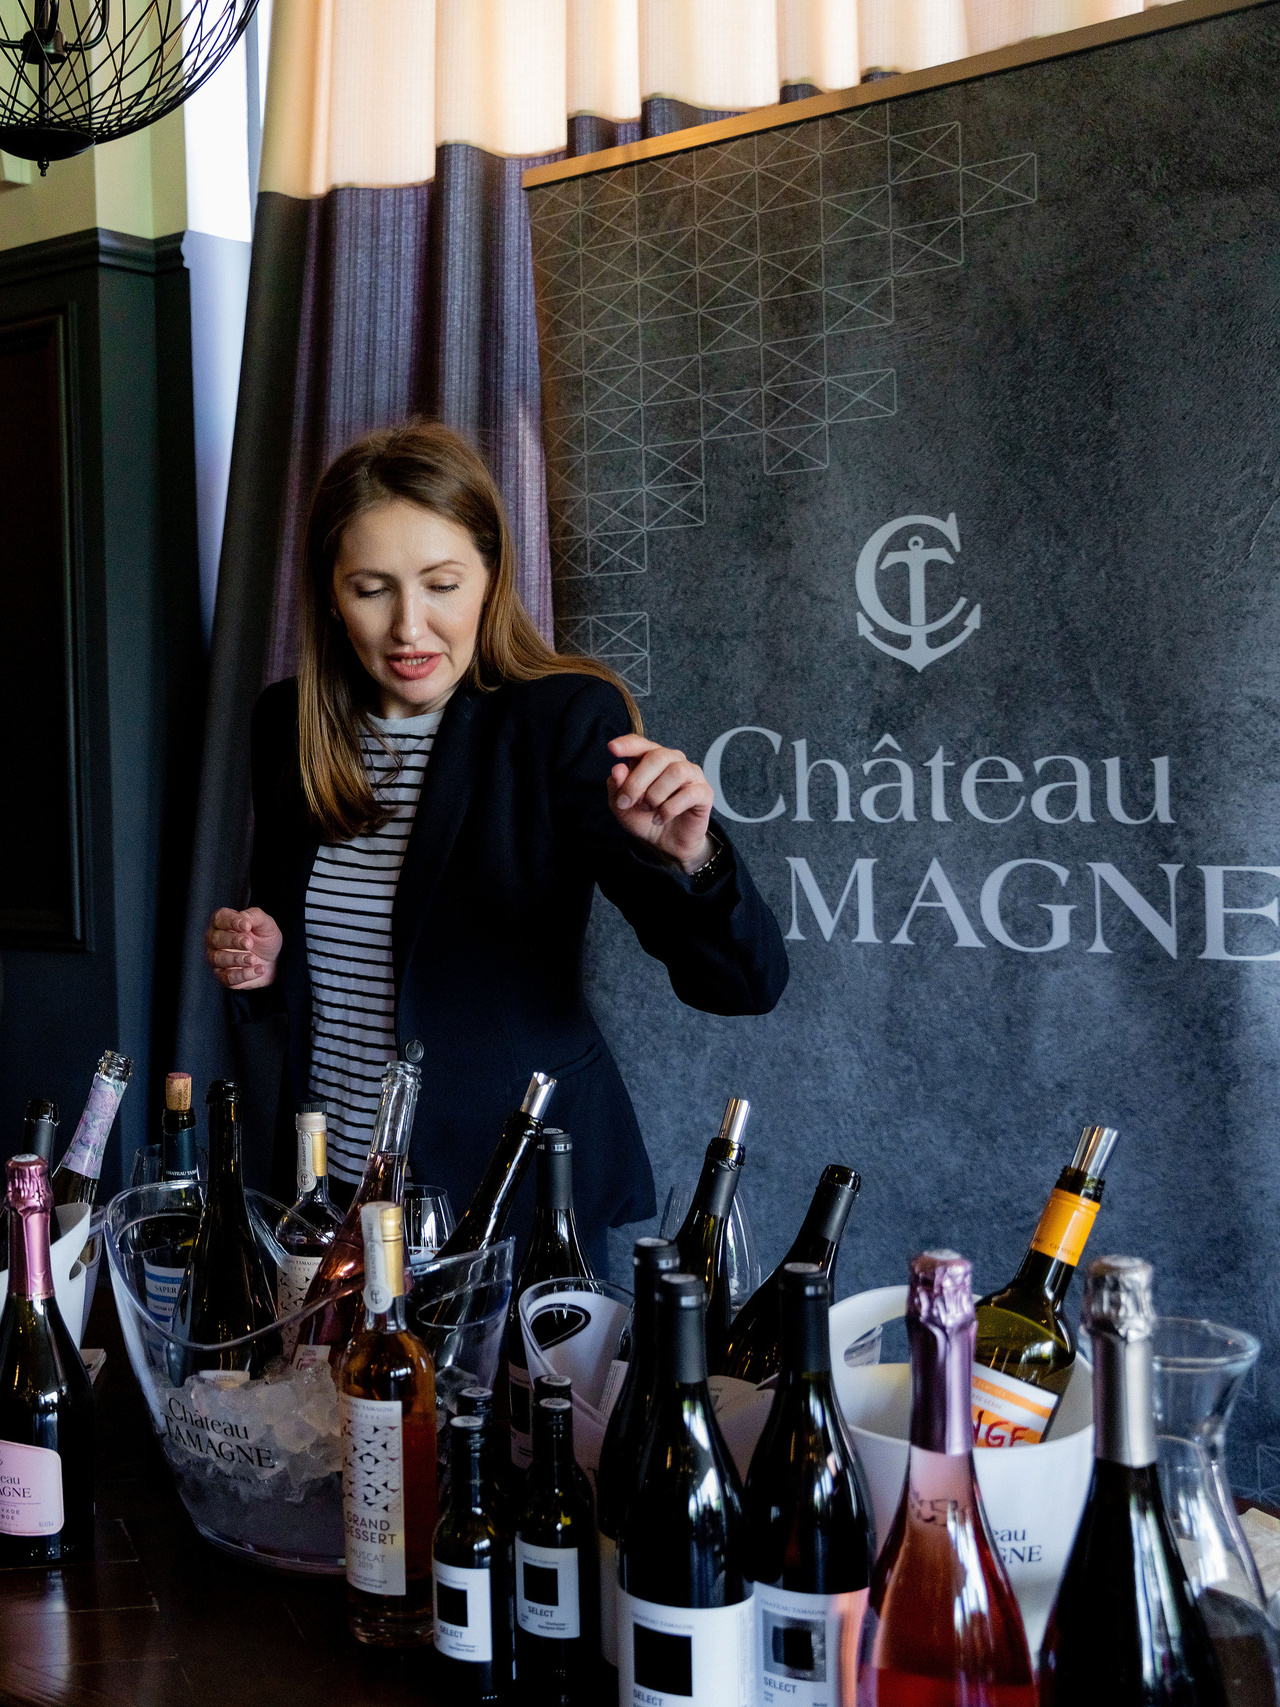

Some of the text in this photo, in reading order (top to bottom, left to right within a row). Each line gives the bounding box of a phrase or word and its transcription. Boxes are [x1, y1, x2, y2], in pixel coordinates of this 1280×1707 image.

[702, 725, 1177, 825] Château
[784, 856, 1280, 962] MAGNE
[154, 1284, 177, 1294] SAPER
[167, 1397, 250, 1440] Château
[160, 1412, 276, 1469] TAMAGNE
[346, 1510, 391, 1532] GRAND
[349, 1546, 386, 1564] MUSCAT
[527, 1605, 555, 1618] SELECT
[439, 1624, 464, 1639] SELECT
[763, 1675, 798, 1694] SELECT
[632, 1687, 664, 1707] SELECT
